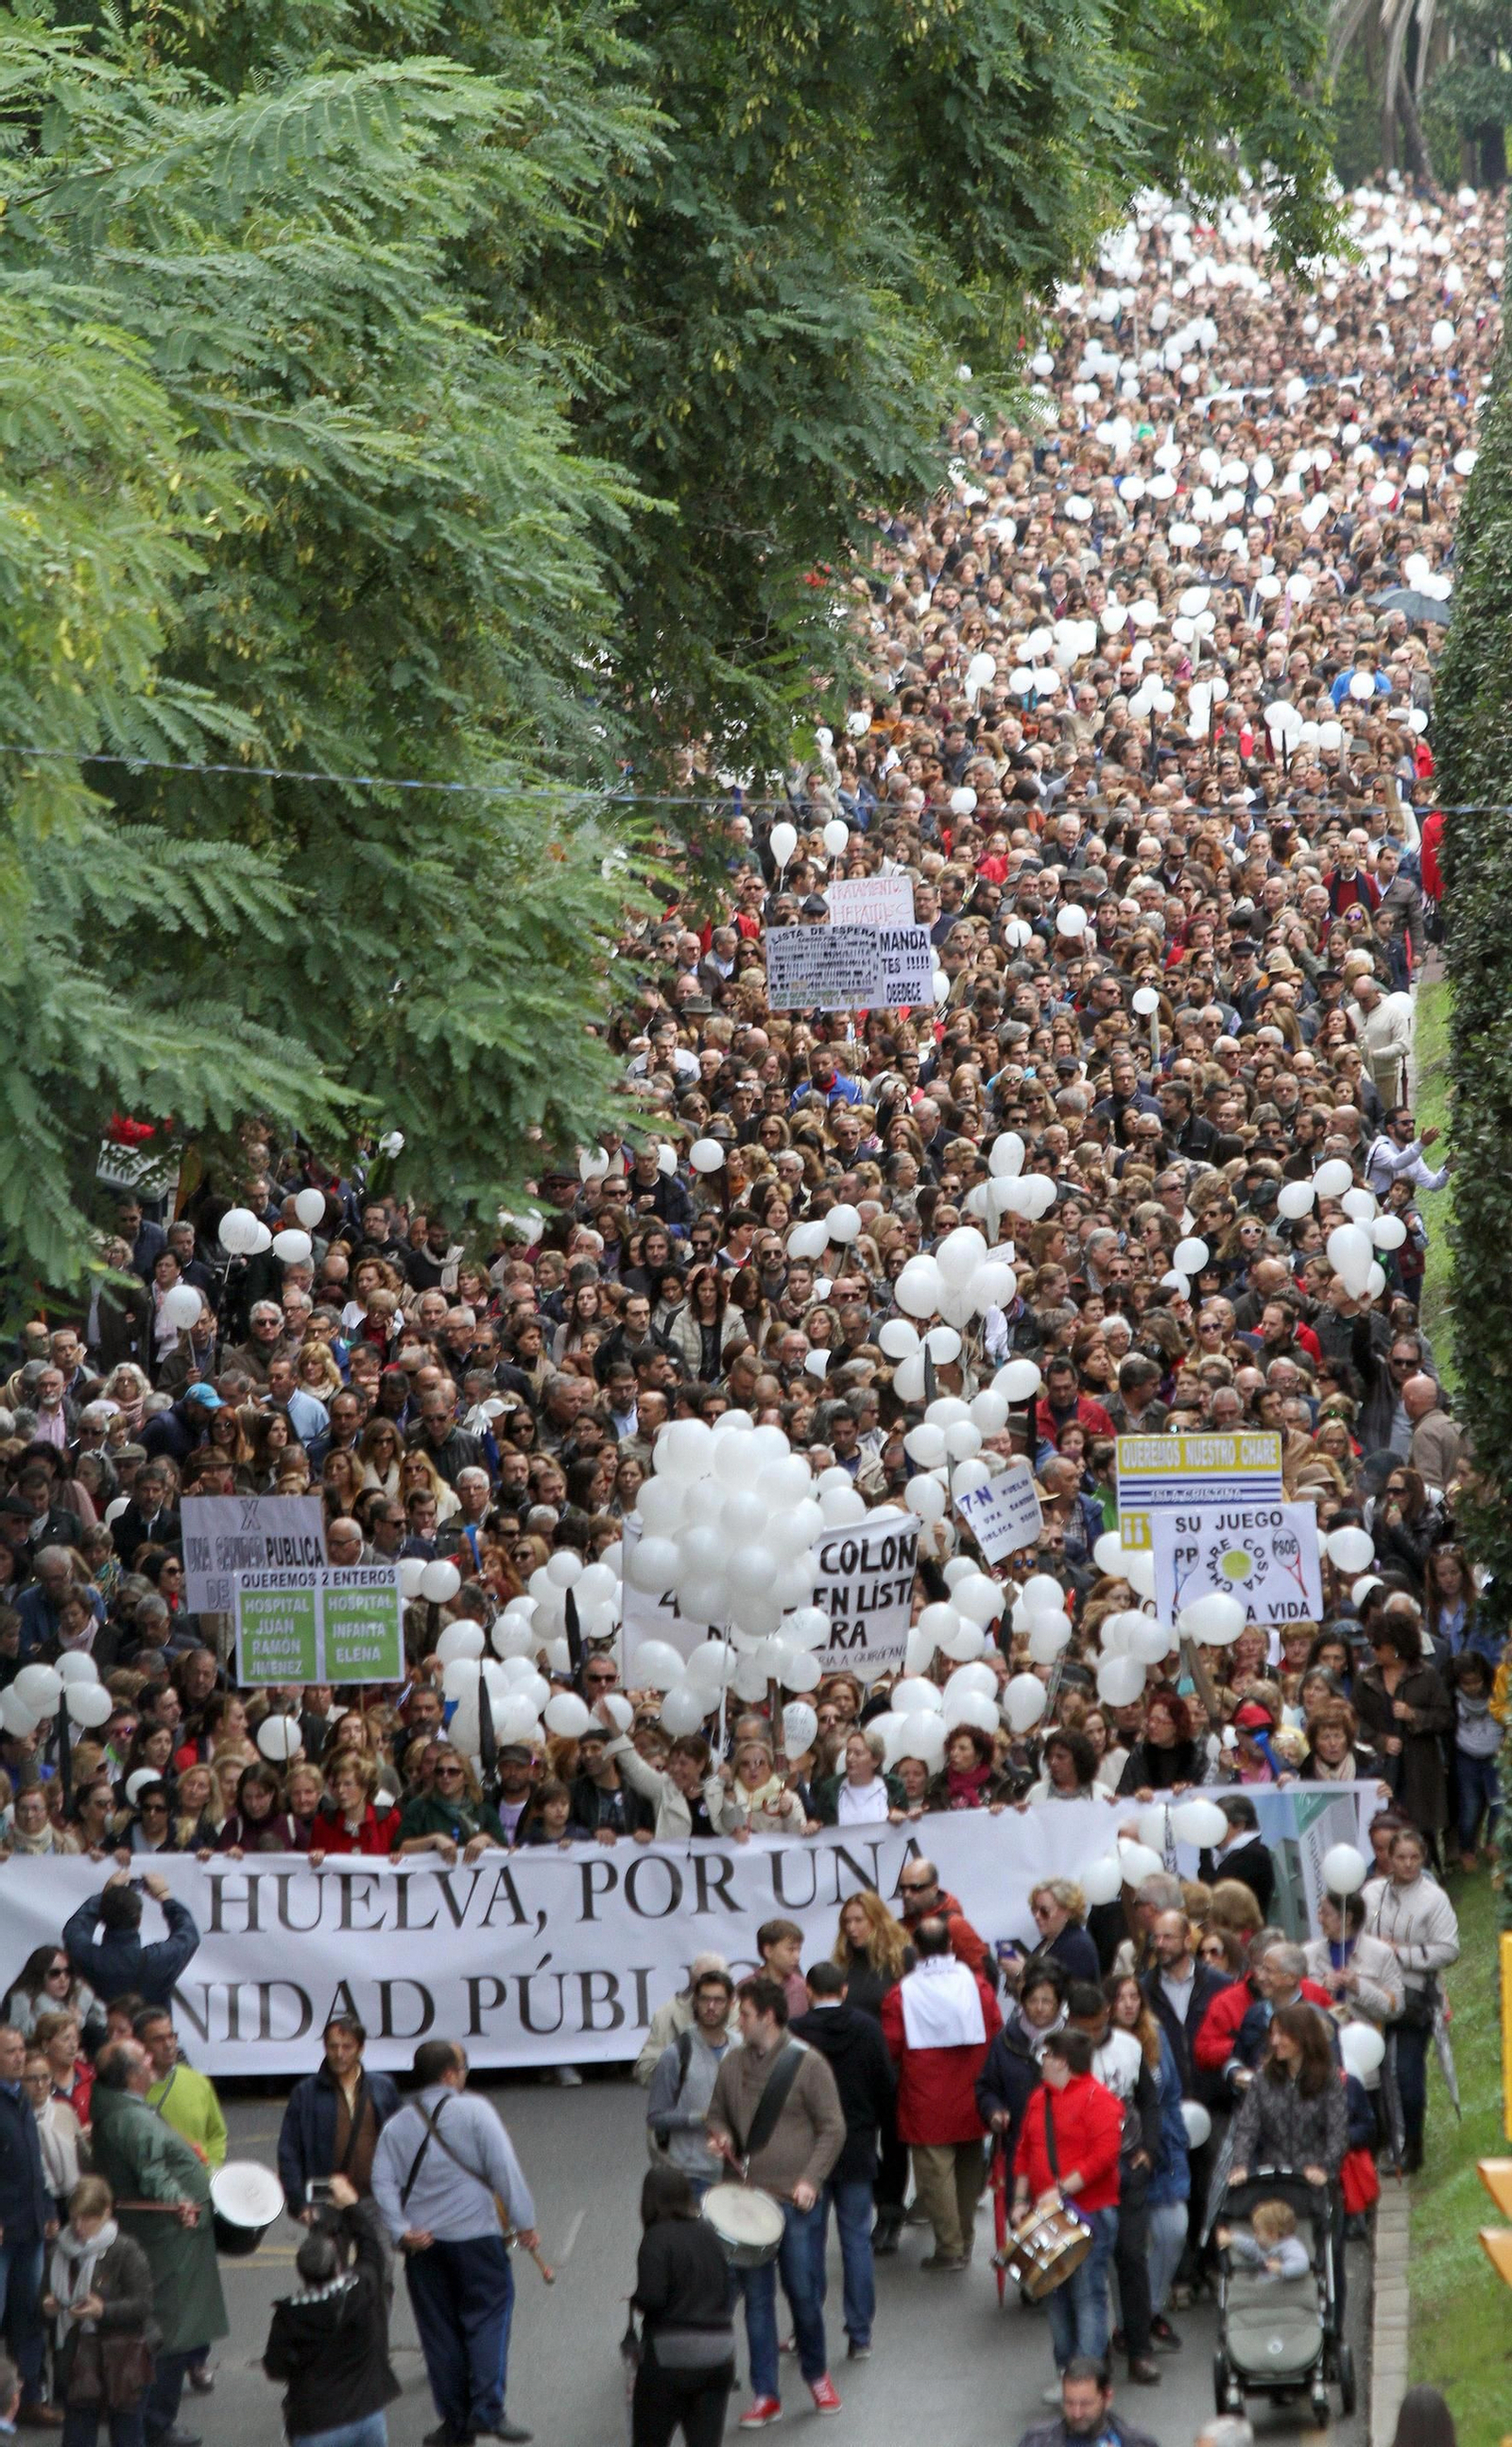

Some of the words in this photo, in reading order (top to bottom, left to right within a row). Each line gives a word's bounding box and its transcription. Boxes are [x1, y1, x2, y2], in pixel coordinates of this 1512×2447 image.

[771, 929, 803, 945] LISTA
[810, 926, 825, 936] DE
[832, 926, 876, 939] ESPERA
[880, 930, 928, 953] MANDA
[881, 956, 901, 974] TES
[886, 982, 921, 1003] OBEDECE
[1122, 1439, 1180, 1469] QUEREMOS
[1184, 1438, 1236, 1467] NUESTRO
[1240, 1438, 1277, 1465] CHARE
[240, 1499, 262, 1530] X
[1176, 1516, 1201, 1533] SU
[1215, 1511, 1283, 1531] JUEGO
[266, 1536, 324, 1568] PUBLICA
[819, 1532, 919, 1576] COLON
[1174, 1547, 1198, 1564] PP
[1273, 1539, 1298, 1557] PSOE
[1206, 1538, 1233, 1594] CHARE
[1242, 1538, 1269, 1592] COSTA
[241, 1572, 317, 1589] QUEREMOS
[321, 1573, 329, 1587] 2
[334, 1569, 396, 1587] ENTEROS
[206, 1578, 231, 1610] DE
[327, 1594, 394, 1611] HOSPITAL
[245, 1596, 310, 1614] HOSPITAL
[1268, 1601, 1311, 1620] VIDA
[255, 1617, 295, 1636] JUAN
[332, 1620, 387, 1639] INFANTA
[812, 1620, 868, 1651] RA
[335, 1646, 381, 1663] ELENA
[203, 1866, 547, 1939] HUELVA,
[575, 1854, 747, 1922] POR
[171, 1978, 435, 2043] NIDAD
